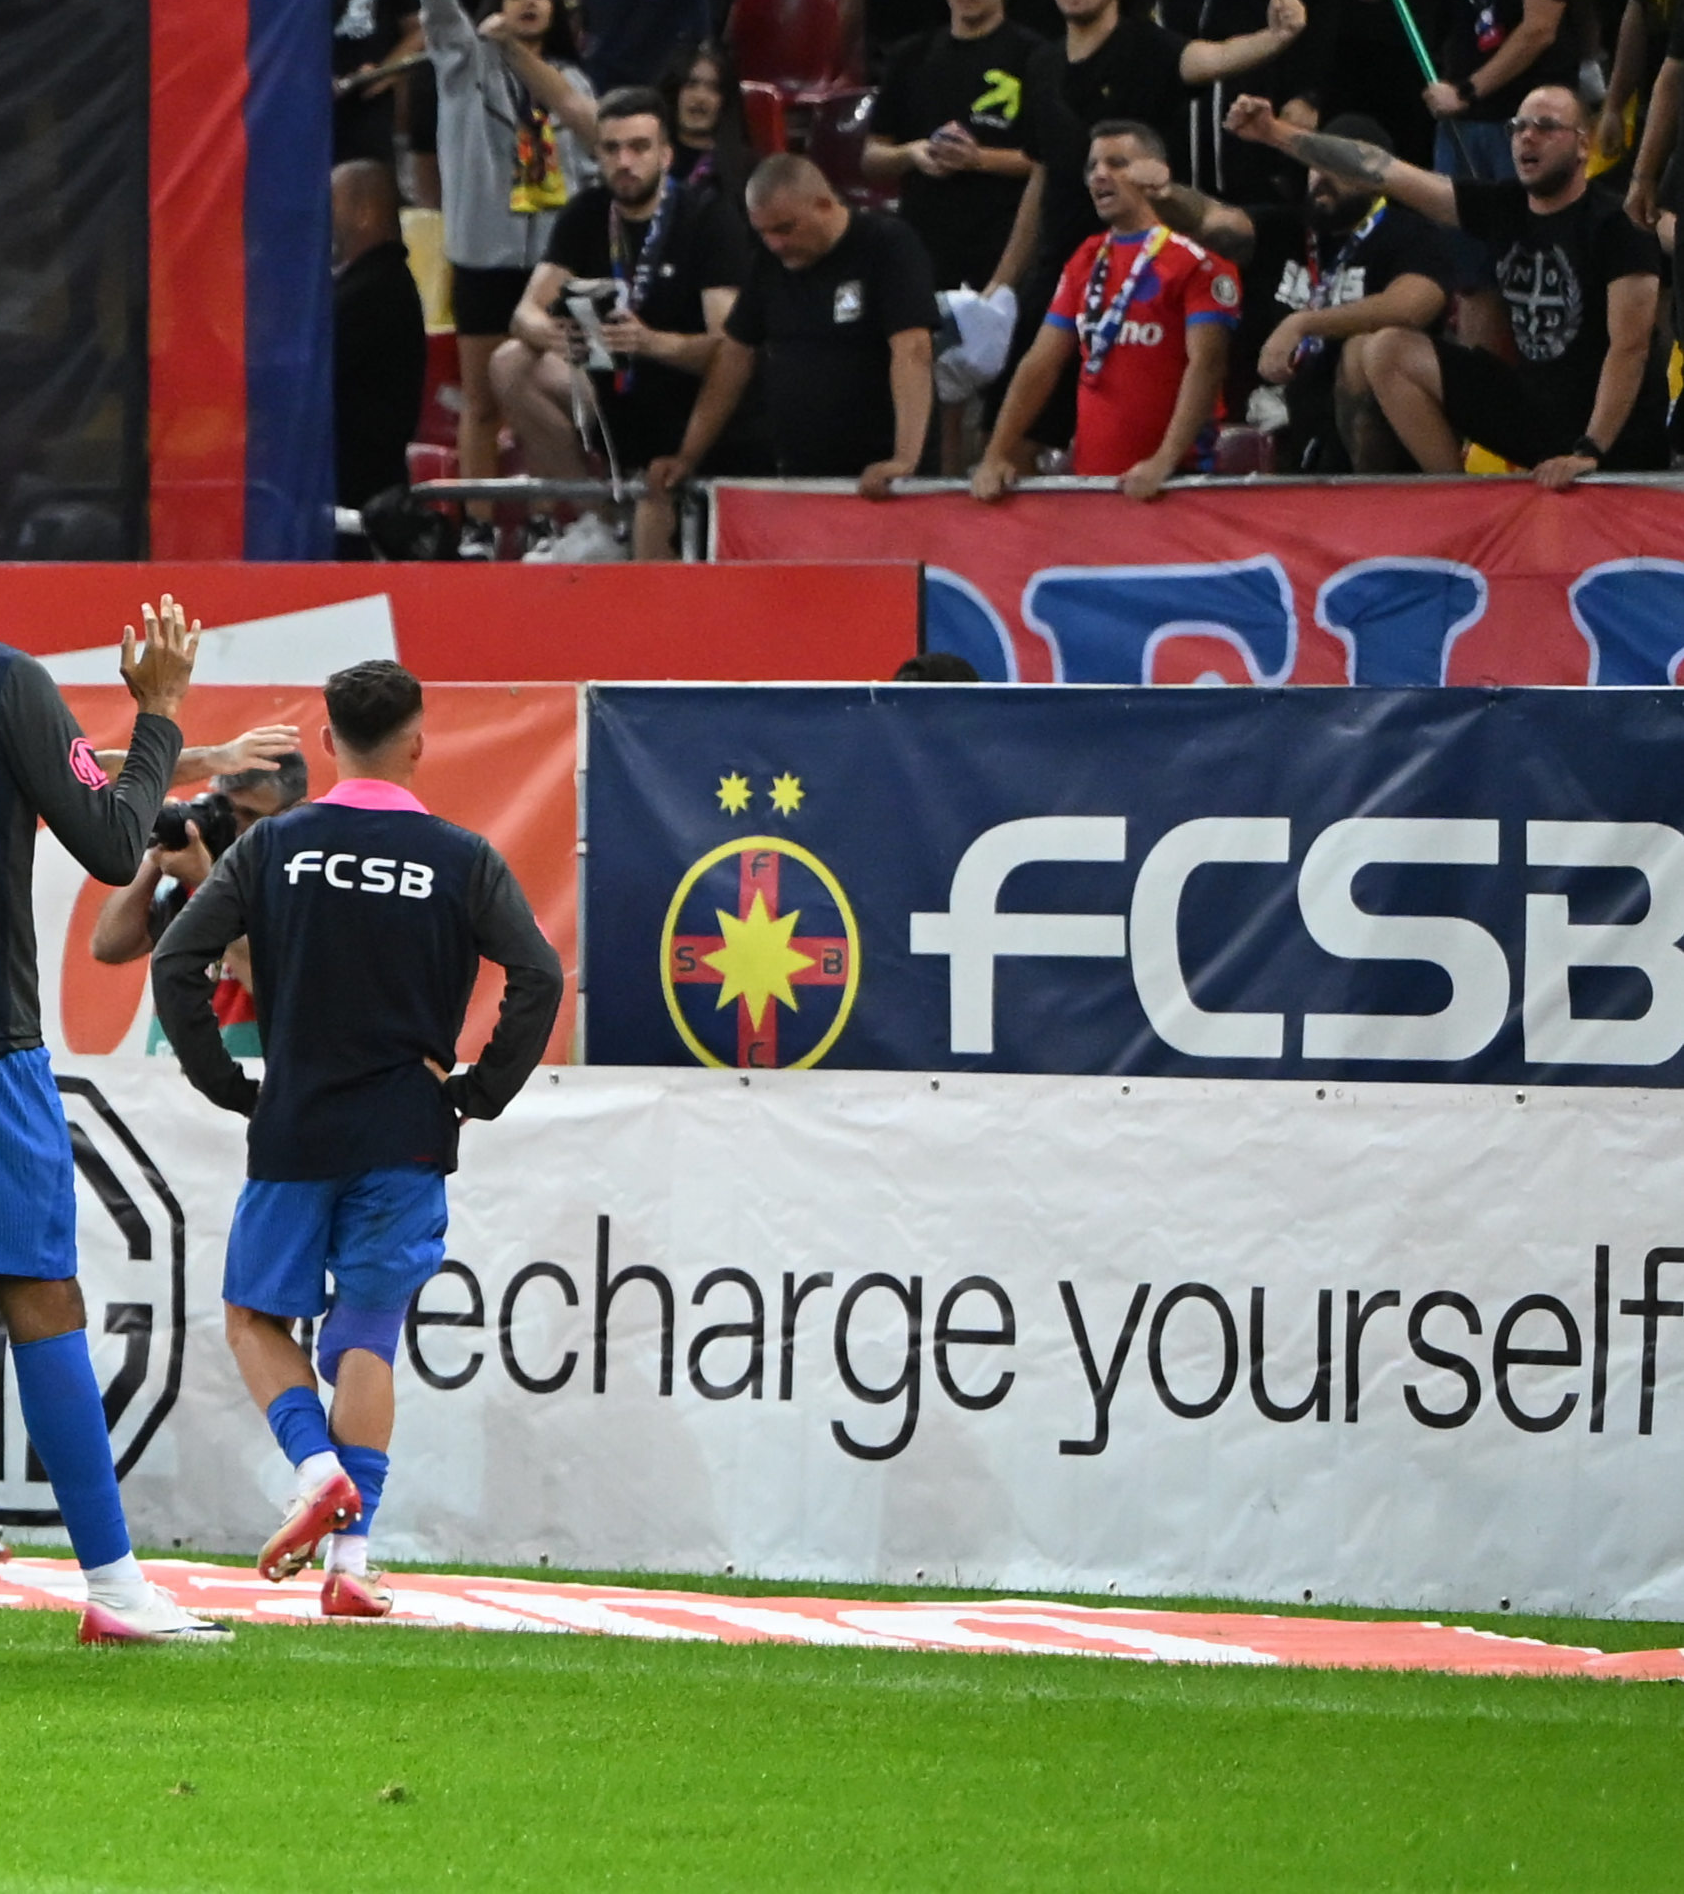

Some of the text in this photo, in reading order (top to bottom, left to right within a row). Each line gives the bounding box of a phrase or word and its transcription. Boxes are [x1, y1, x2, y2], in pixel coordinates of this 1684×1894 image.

[283, 849, 436, 900] FCSB
[909, 814, 1684, 1067] FCSB
[1055, 1243, 1684, 1457] yourself
